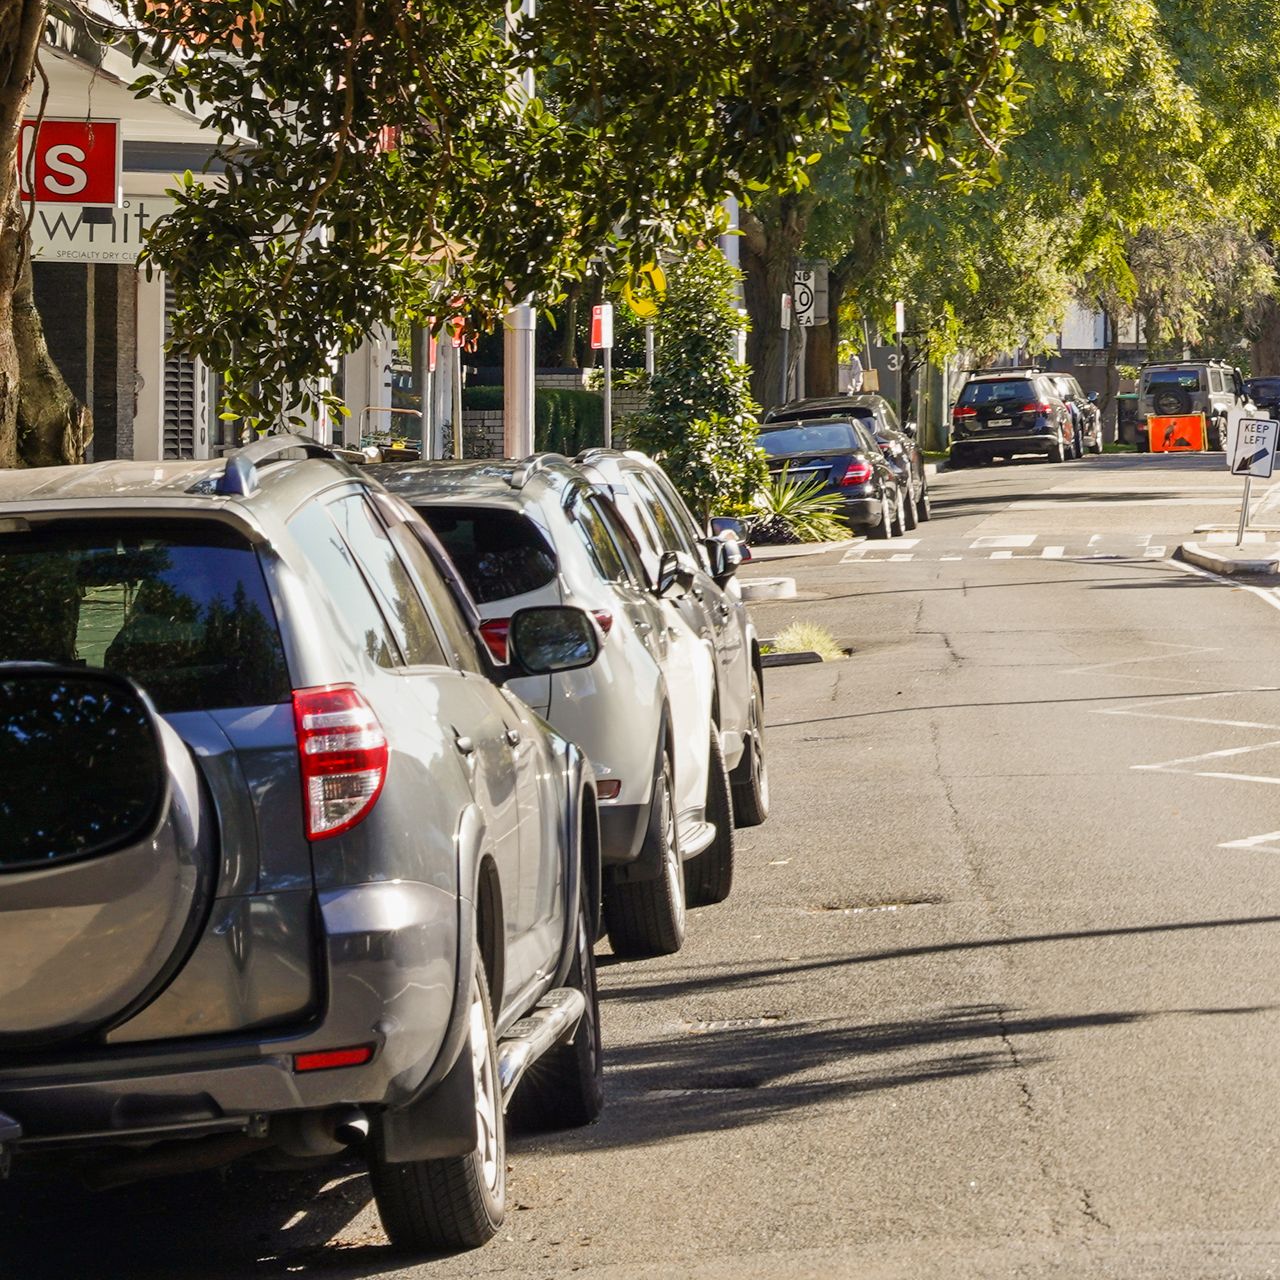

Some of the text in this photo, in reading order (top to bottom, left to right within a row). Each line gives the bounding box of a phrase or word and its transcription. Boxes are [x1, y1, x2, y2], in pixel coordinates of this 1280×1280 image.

[39, 201, 171, 244] whit
[56, 250, 100, 259] SPECIALTY
[121, 252, 138, 260] CLE
[794, 271, 811, 281] ND
[799, 316, 813, 325] EA
[1244, 424, 1270, 433] KEEP
[1244, 436, 1266, 445] LEFT
